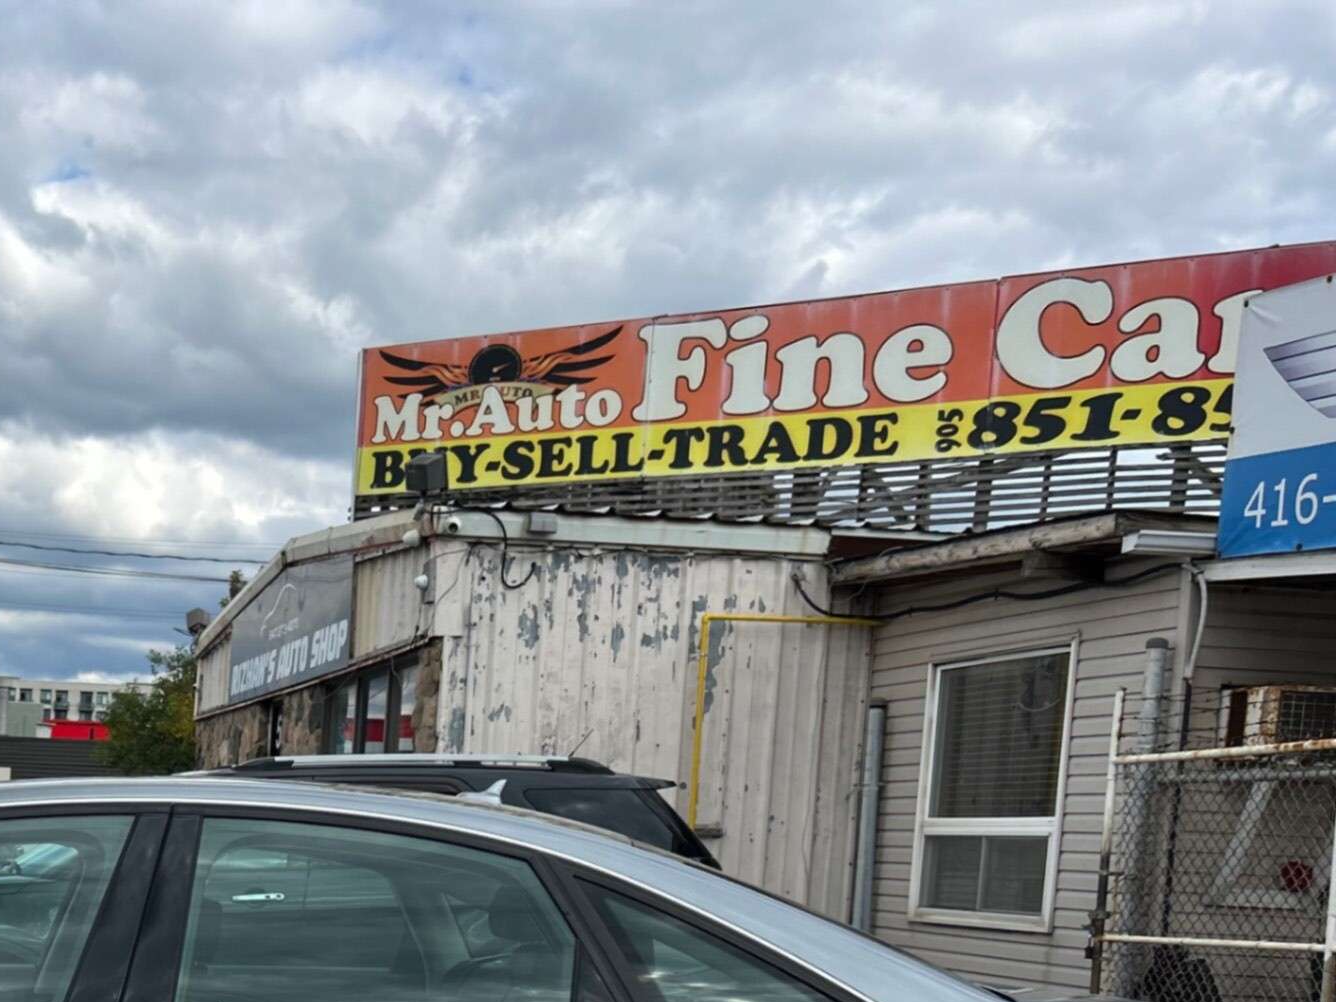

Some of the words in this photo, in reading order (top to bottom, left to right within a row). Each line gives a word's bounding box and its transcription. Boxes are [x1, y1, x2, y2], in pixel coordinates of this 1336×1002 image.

[632, 314, 954, 422] Fine
[370, 411, 899, 489] BY-SELL-TRADE
[1244, 473, 1336, 529] 416-
[276, 634, 309, 681] AUTO
[310, 618, 348, 669] SHOP
